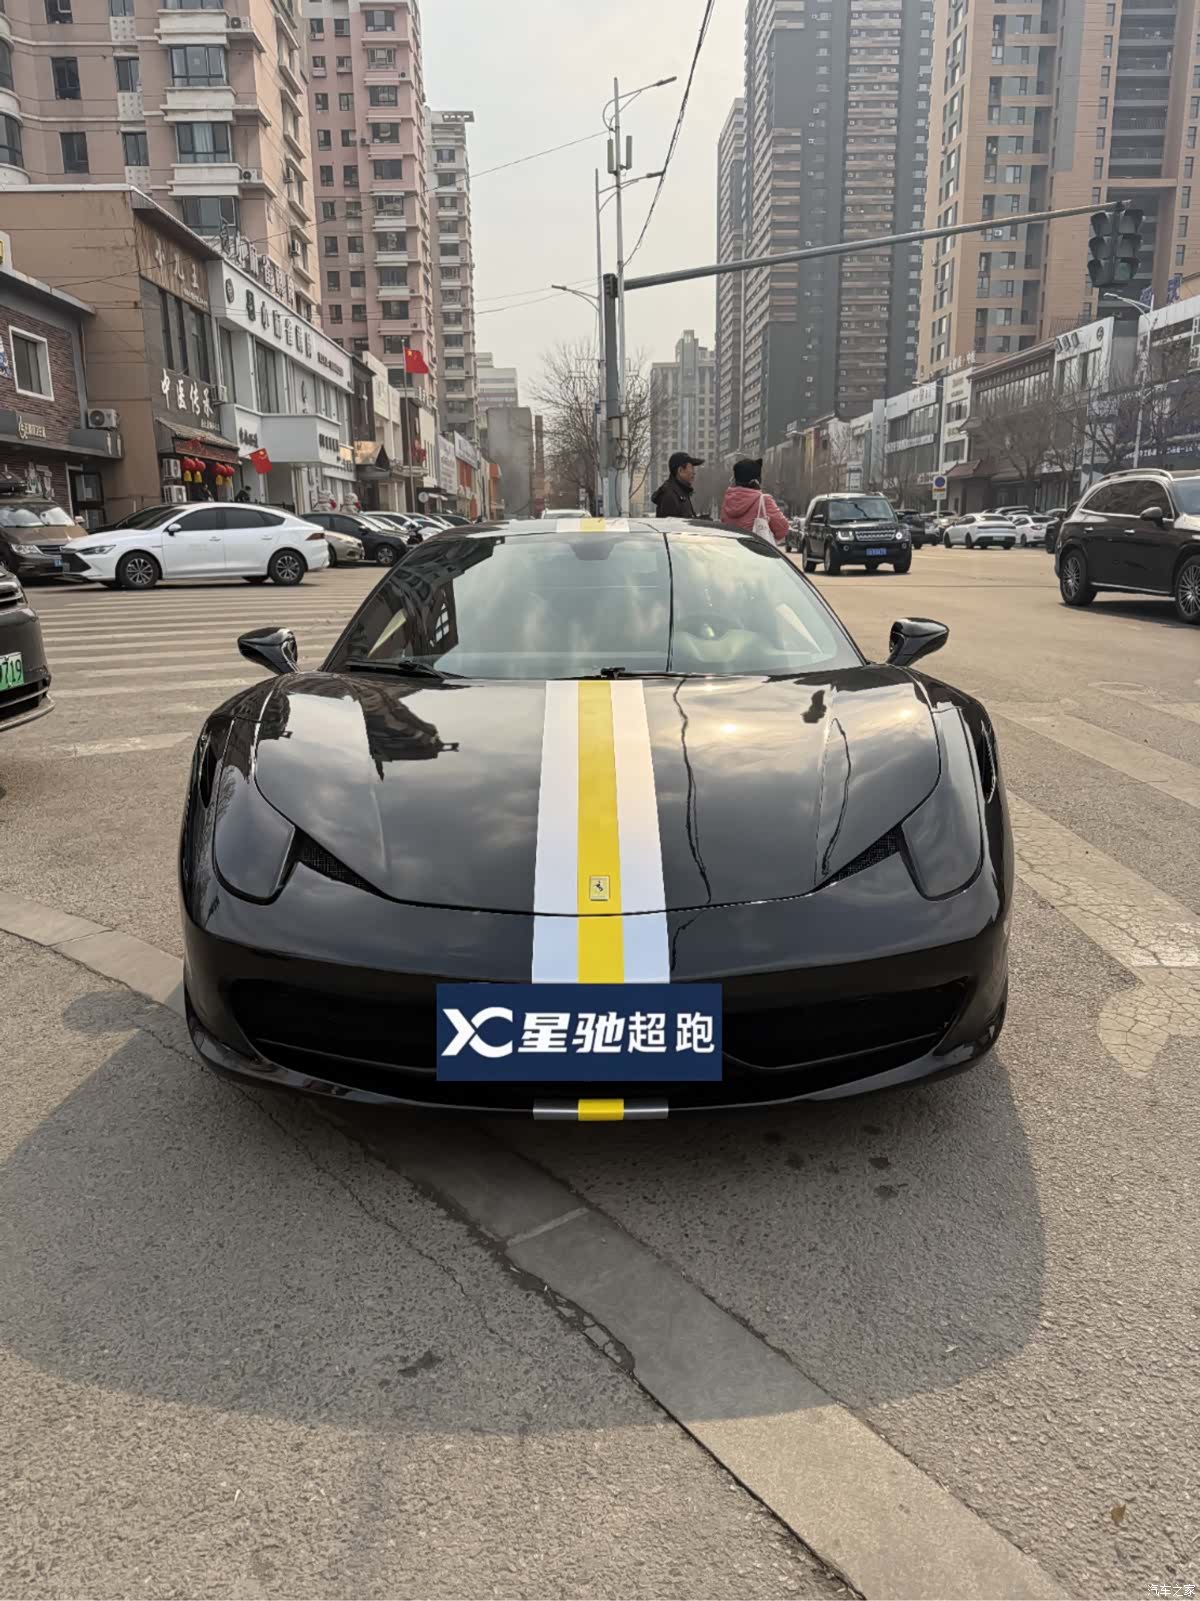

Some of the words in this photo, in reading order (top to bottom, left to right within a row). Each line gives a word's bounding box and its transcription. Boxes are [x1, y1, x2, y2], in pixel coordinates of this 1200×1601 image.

[0, 659, 21, 685] 719
[517, 1011, 715, 1053] 星驰超跑
